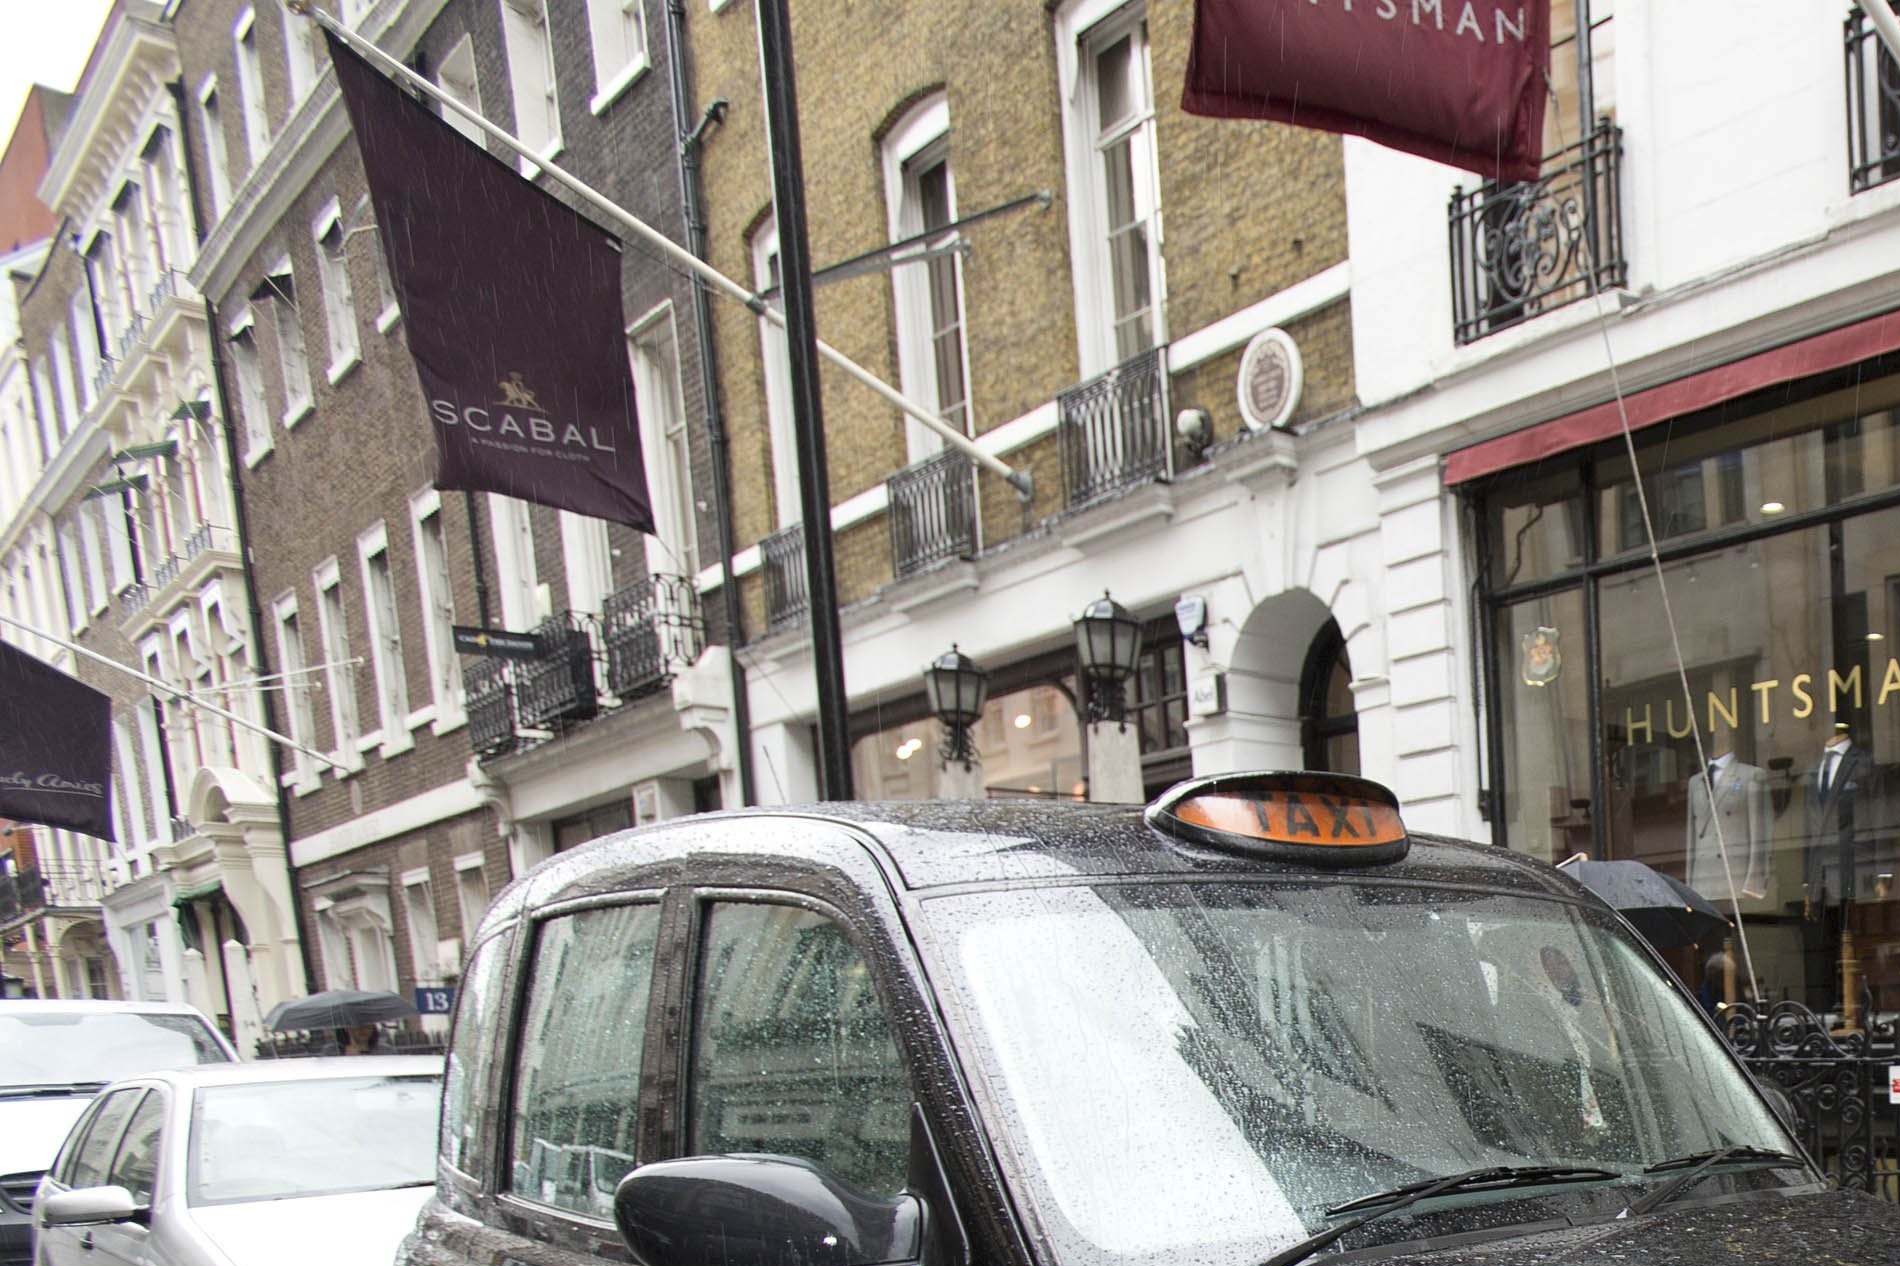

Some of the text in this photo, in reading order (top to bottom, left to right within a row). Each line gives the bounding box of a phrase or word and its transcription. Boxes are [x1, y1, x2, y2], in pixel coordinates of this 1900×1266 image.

[431, 399, 616, 453] SCABAL
[1243, 791, 1378, 838] TAXI
[424, 991, 449, 1012] 13
